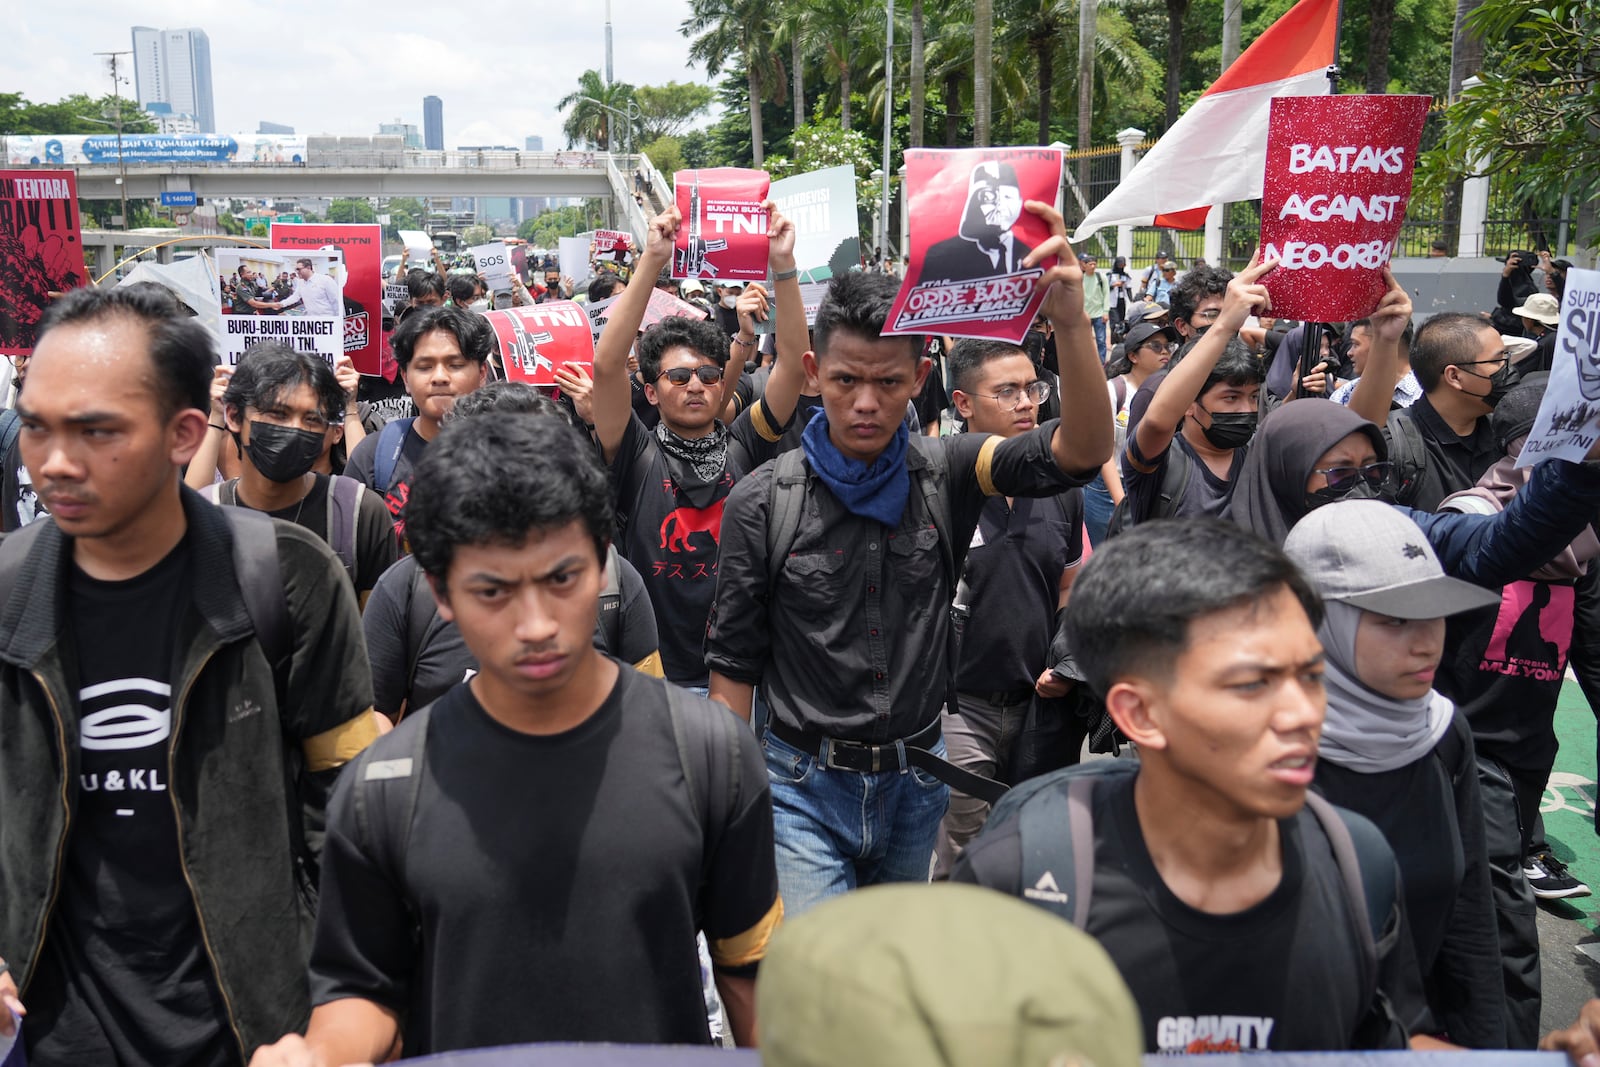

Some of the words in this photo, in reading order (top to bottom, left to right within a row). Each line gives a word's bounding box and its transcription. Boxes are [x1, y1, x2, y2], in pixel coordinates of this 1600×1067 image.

[1288, 144, 1404, 175] BATAKS
[15, 178, 71, 199] TENTARA
[707, 205, 739, 213] BUKAN
[706, 212, 767, 235] TNI
[480, 255, 504, 268] SOS
[1264, 240, 1391, 271] NEO-ORBA
[921, 279, 951, 289] STAR
[909, 285, 969, 311] ORDE
[973, 277, 1033, 304] BARU
[522, 309, 584, 327] TNI
[900, 302, 978, 322] STRIKES
[978, 297, 1027, 313] BACK
[983, 313, 1016, 323] WARS
[228, 319, 289, 335] BURU-BURU
[292, 320, 334, 335] BANGET
[344, 318, 365, 336] RU
[297, 336, 318, 352] TNI,
[344, 332, 366, 343] ACK
[1568, 433, 1593, 449] TNI
[1157, 1014, 1274, 1050] GRAVITY
